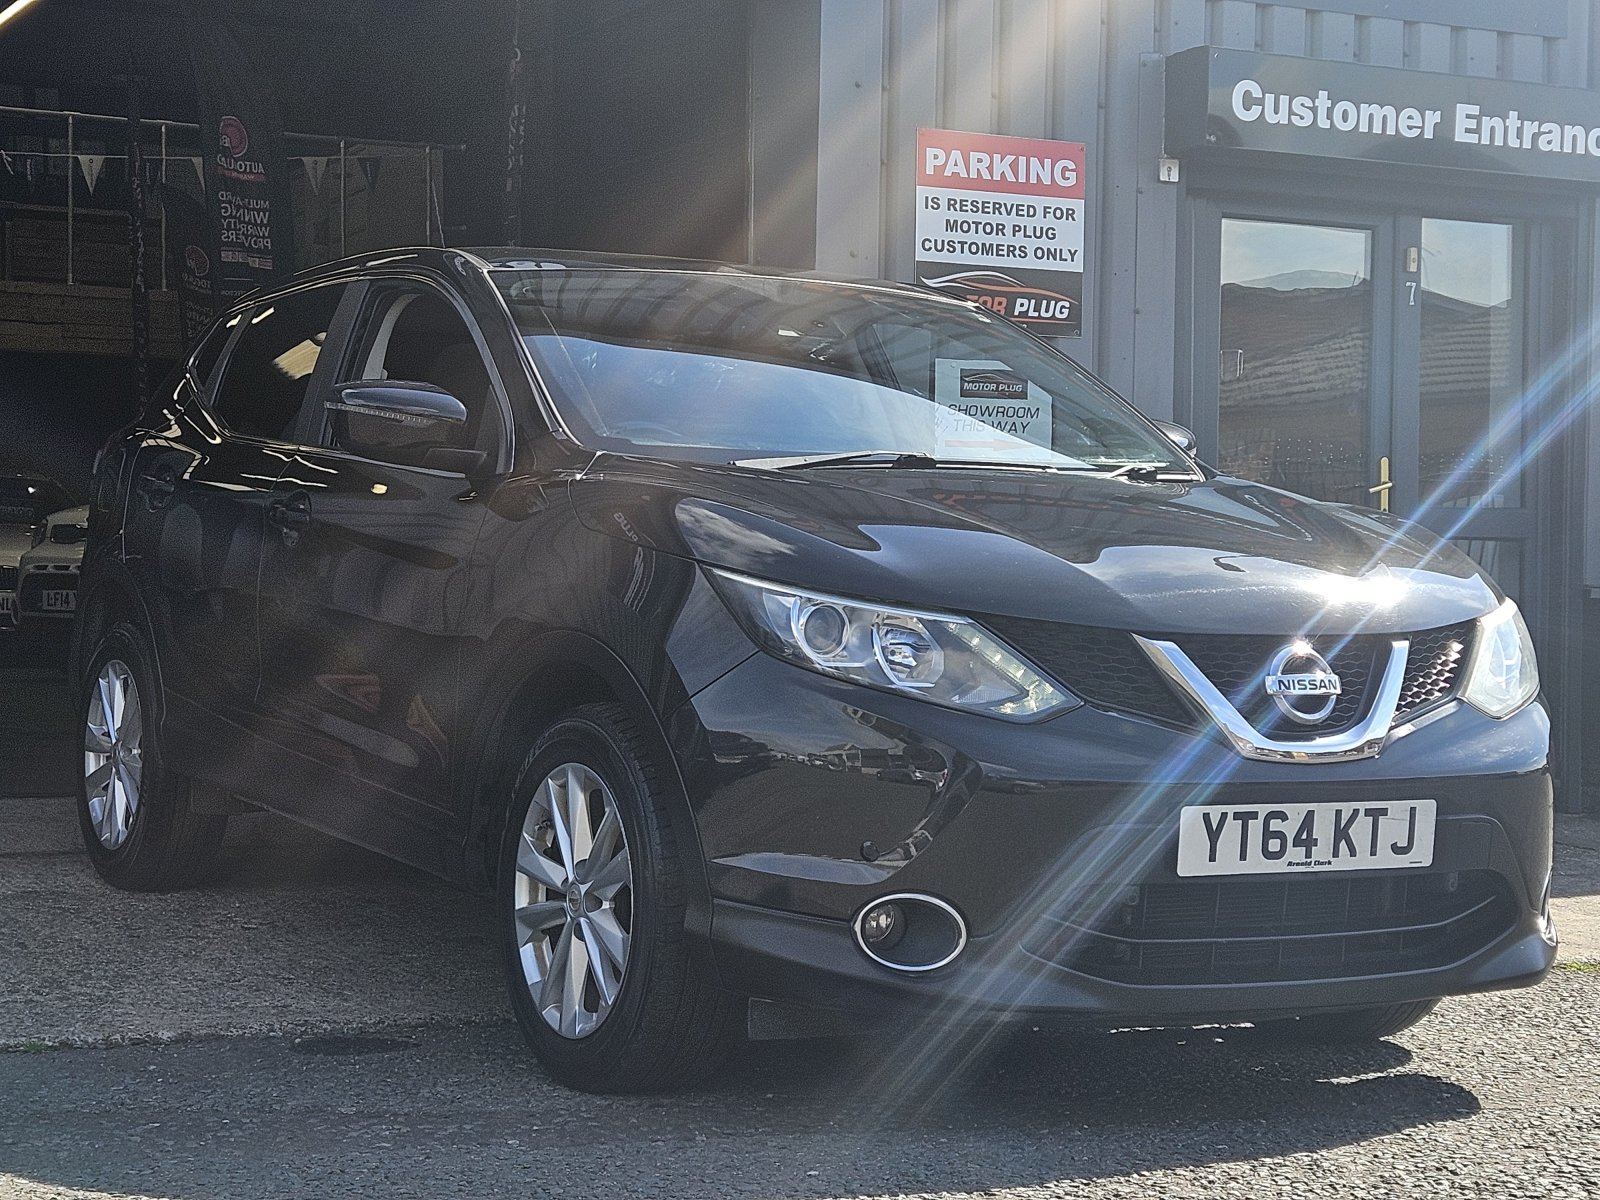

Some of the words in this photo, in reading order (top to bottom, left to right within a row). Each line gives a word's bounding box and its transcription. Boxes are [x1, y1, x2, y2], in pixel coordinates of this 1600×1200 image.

[1232, 78, 1442, 140] Customer
[1454, 103, 1600, 156] Entranc
[926, 147, 1077, 187] PARKING
[924, 196, 941, 210] IS
[947, 198, 1037, 218] RESERVED
[1043, 206, 1076, 222] FOR
[945, 219, 1006, 236] MOTOR
[1012, 224, 1057, 240] PLUG
[921, 238, 1028, 258] CUSTOMERS
[1034, 246, 1078, 262] ONLY
[1406, 282, 1416, 306] 7
[1014, 298, 1070, 318] PLUG
[964, 382, 996, 392] MOTOR
[998, 384, 1022, 392] PLUG
[947, 404, 1040, 419] SHOWROOM
[954, 418, 986, 432] THIS
[991, 420, 1030, 434] WAY
[1277, 678, 1338, 692] NISSAN
[1202, 809, 1318, 863] YT64
[1332, 806, 1416, 858] KTJ
